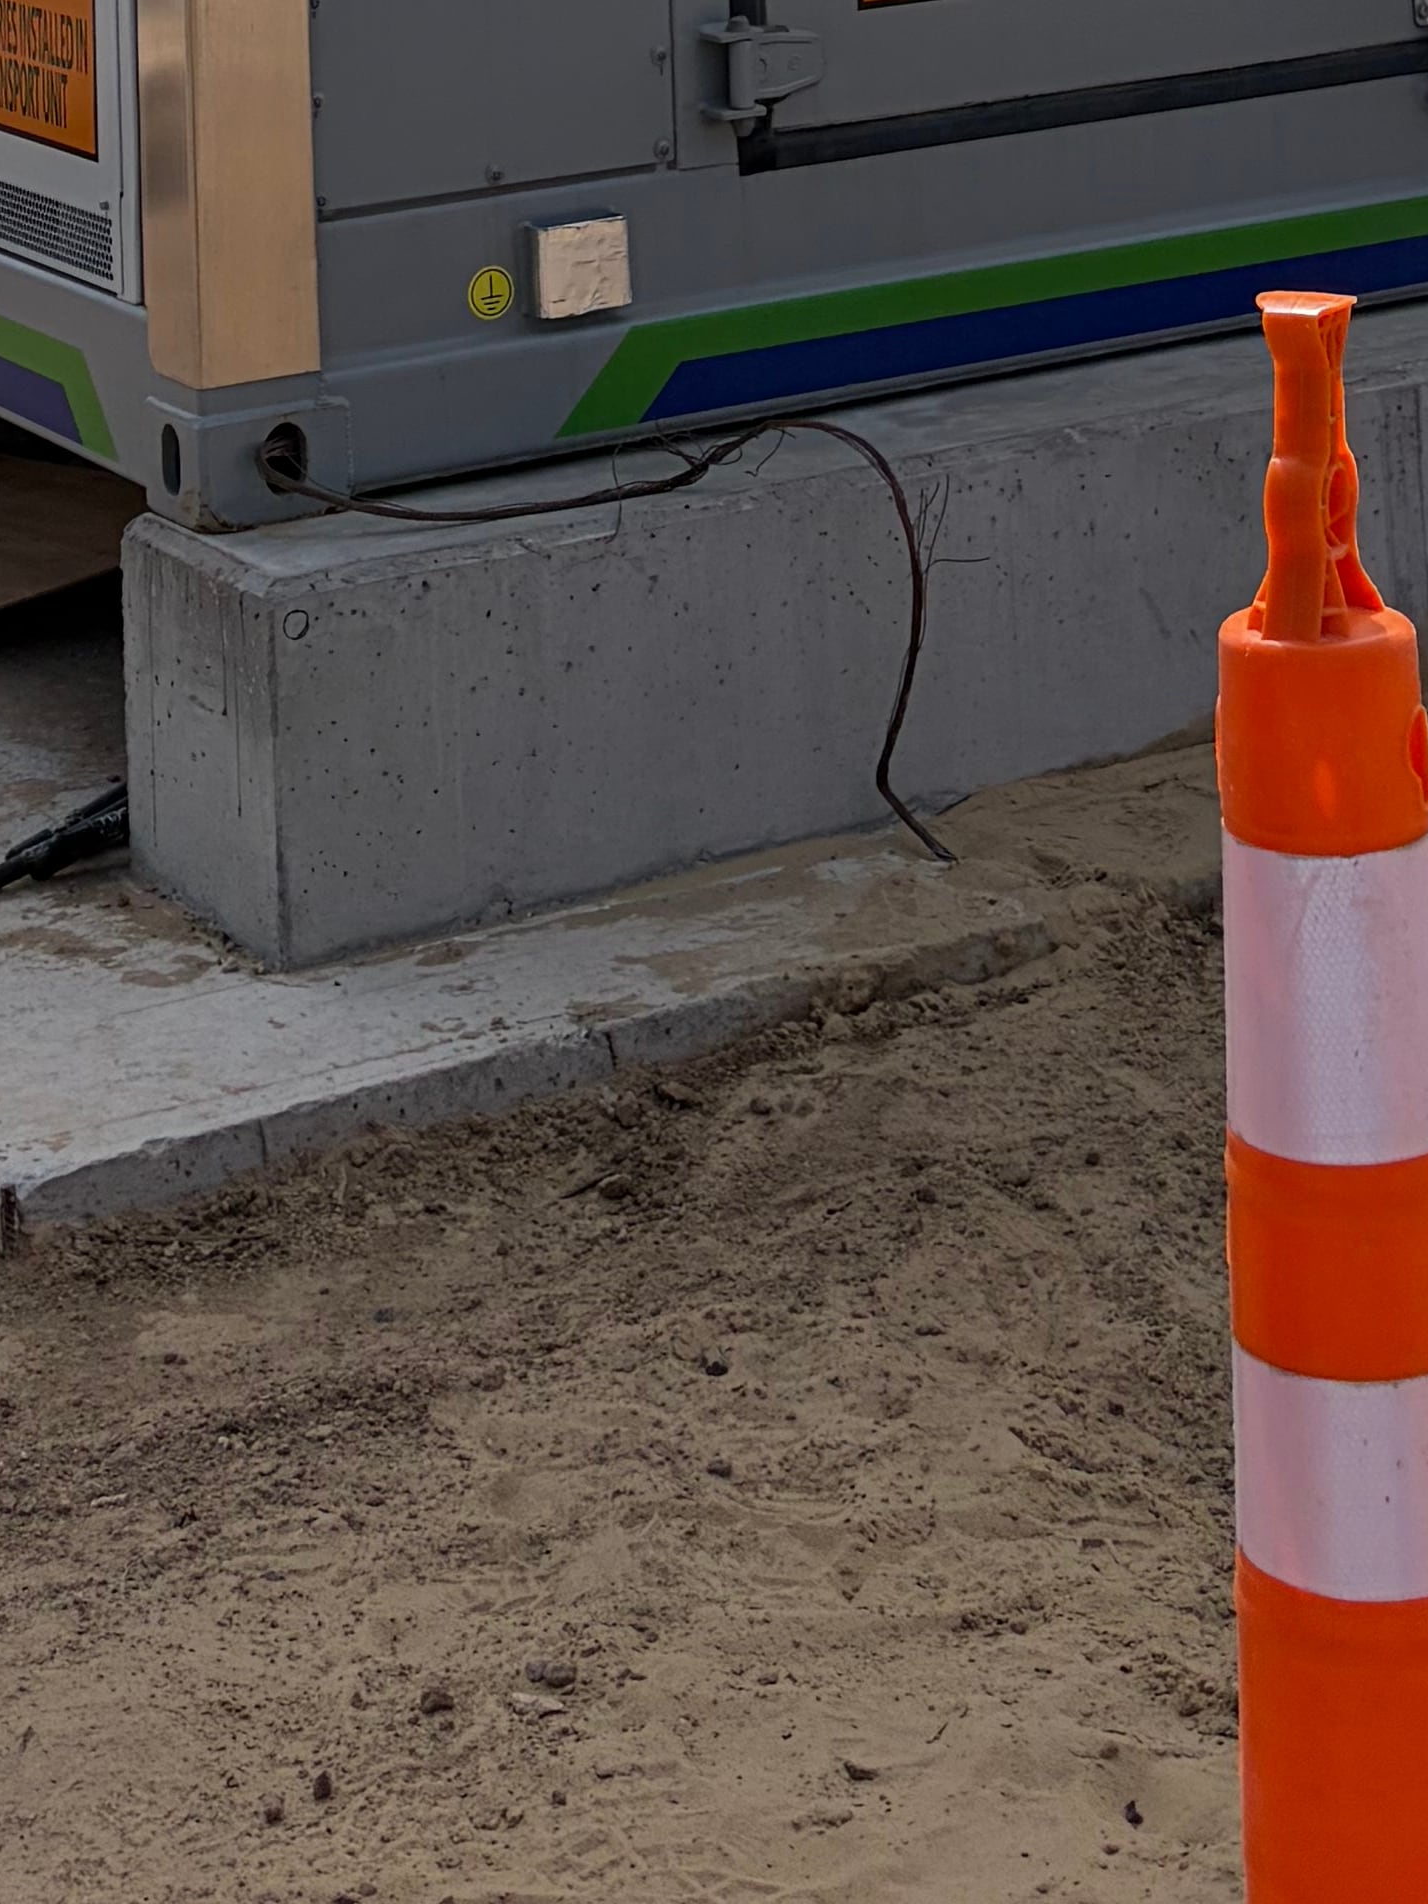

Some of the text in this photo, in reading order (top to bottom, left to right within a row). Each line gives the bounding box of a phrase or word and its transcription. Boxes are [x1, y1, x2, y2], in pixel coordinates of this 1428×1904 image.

[20, 4, 73, 70] INSTALLED
[76, 16, 88, 75] IN
[41, 70, 68, 129] UNIT
